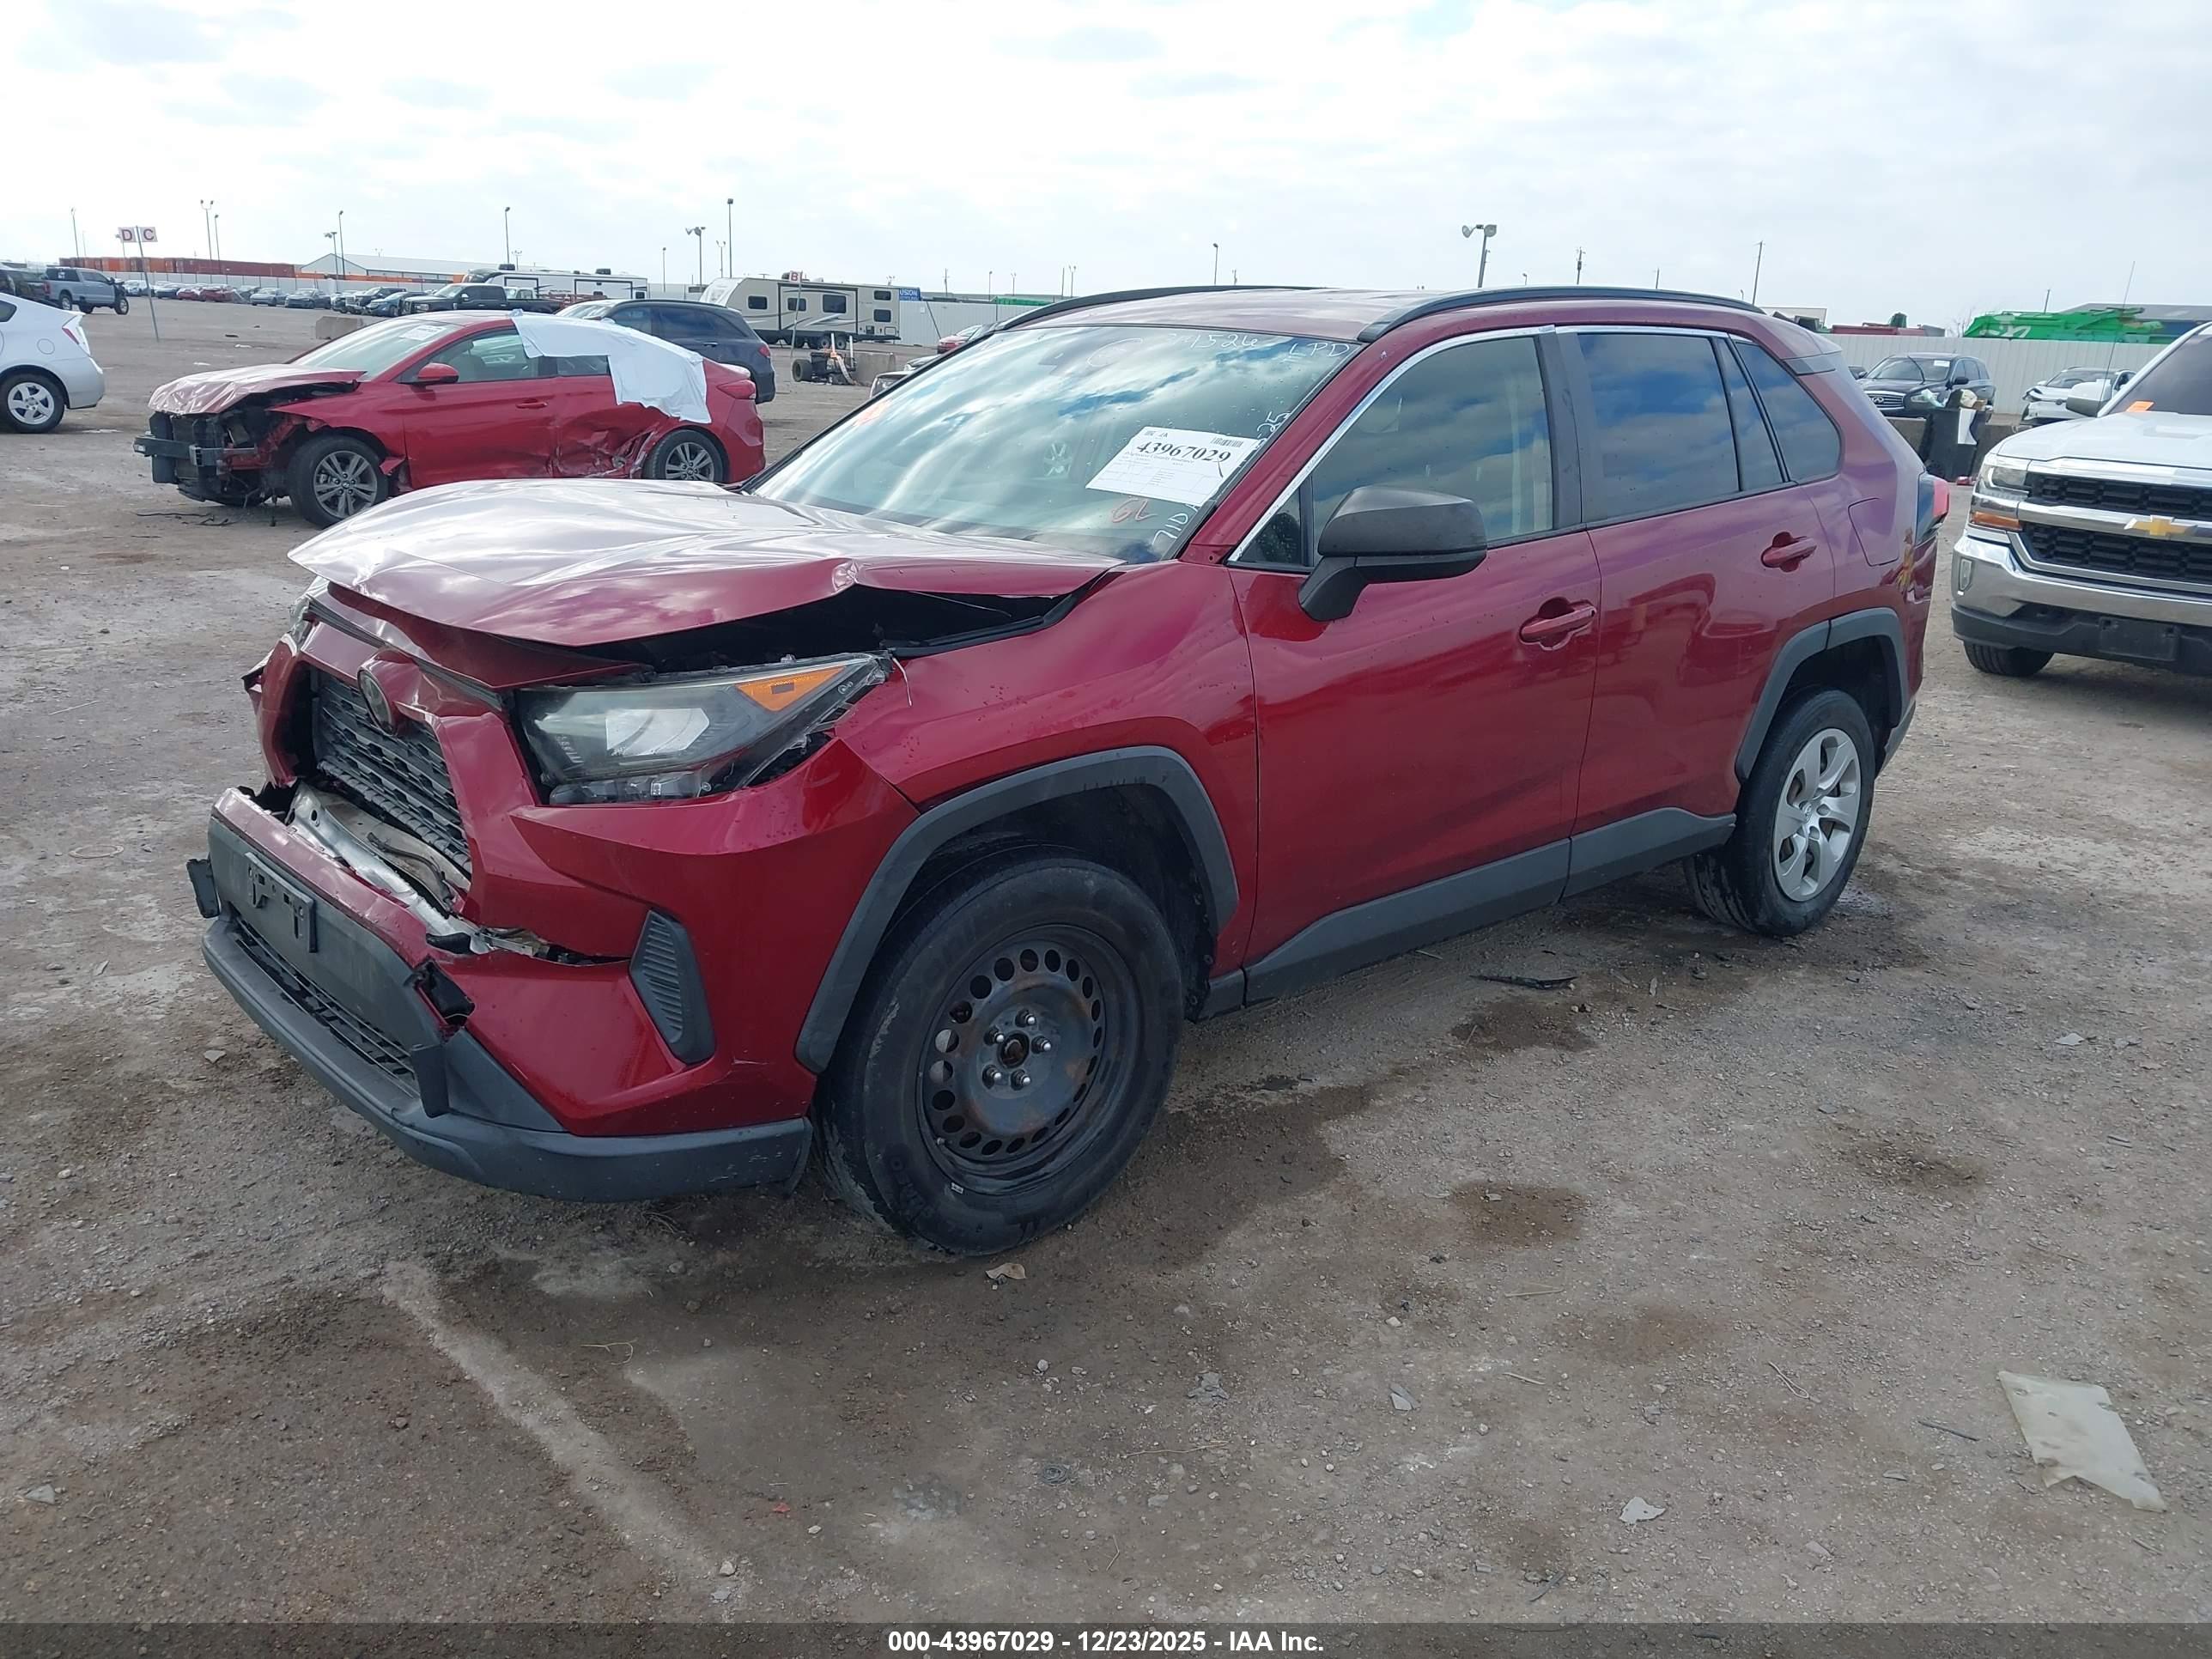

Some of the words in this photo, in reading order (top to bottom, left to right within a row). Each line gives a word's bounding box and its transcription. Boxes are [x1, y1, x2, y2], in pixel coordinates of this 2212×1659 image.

[121, 229, 133, 240] D
[143, 228, 155, 240] C
[791, 271, 799, 282] B
[1136, 441, 1231, 463] 43967029
